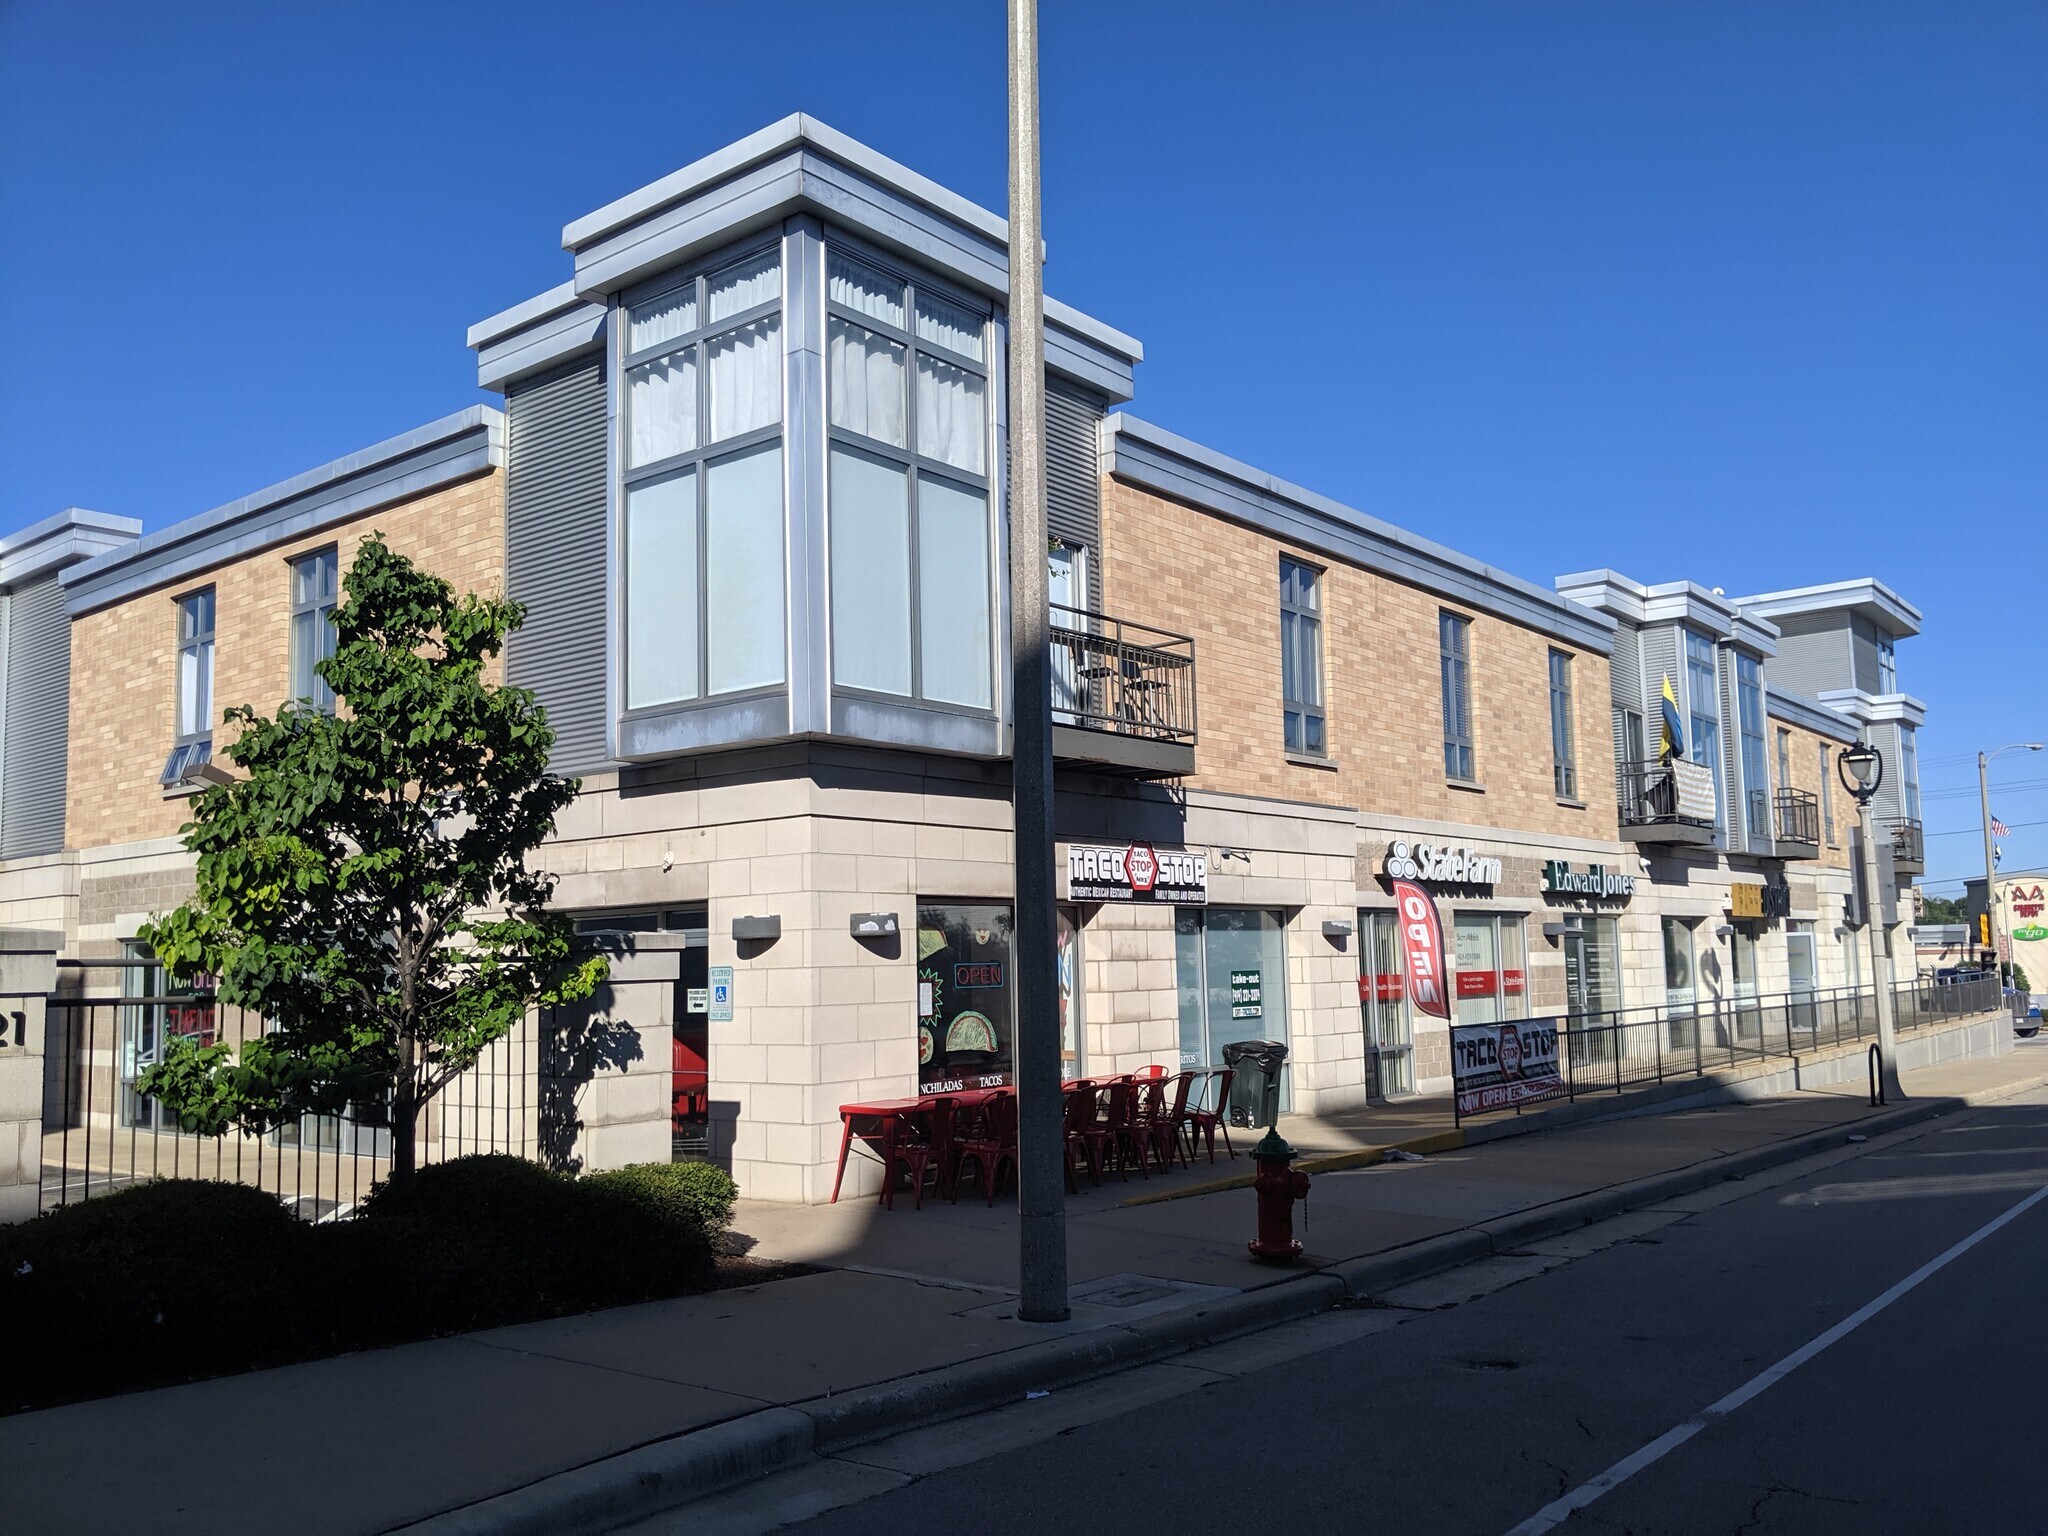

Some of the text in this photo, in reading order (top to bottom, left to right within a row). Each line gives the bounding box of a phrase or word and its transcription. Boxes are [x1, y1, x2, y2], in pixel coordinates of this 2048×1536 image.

[1070, 848, 1206, 886] TACO STOP
[1131, 860, 1152, 873] STOP
[1554, 861, 1636, 898] Edward Jones
[1093, 887, 1109, 898] MEXICAN
[1109, 888, 1133, 899] RESTAURANT
[1155, 889, 1168, 900] FAMILY
[1168, 890, 1180, 900] OWNED
[1188, 891, 1205, 901] OPERATED
[2026, 929, 2044, 938] go
[957, 967, 1001, 985] OPEN
[1232, 974, 1260, 984] take-out
[1456, 1037, 1498, 1070] TACO
[1522, 1028, 1558, 1059] STOP
[1503, 1047, 1518, 1060] STOP
[979, 1074, 1003, 1087] TACOS
[1459, 1093, 1480, 1112] NOW
[1482, 1088, 1506, 1106] OPEN
